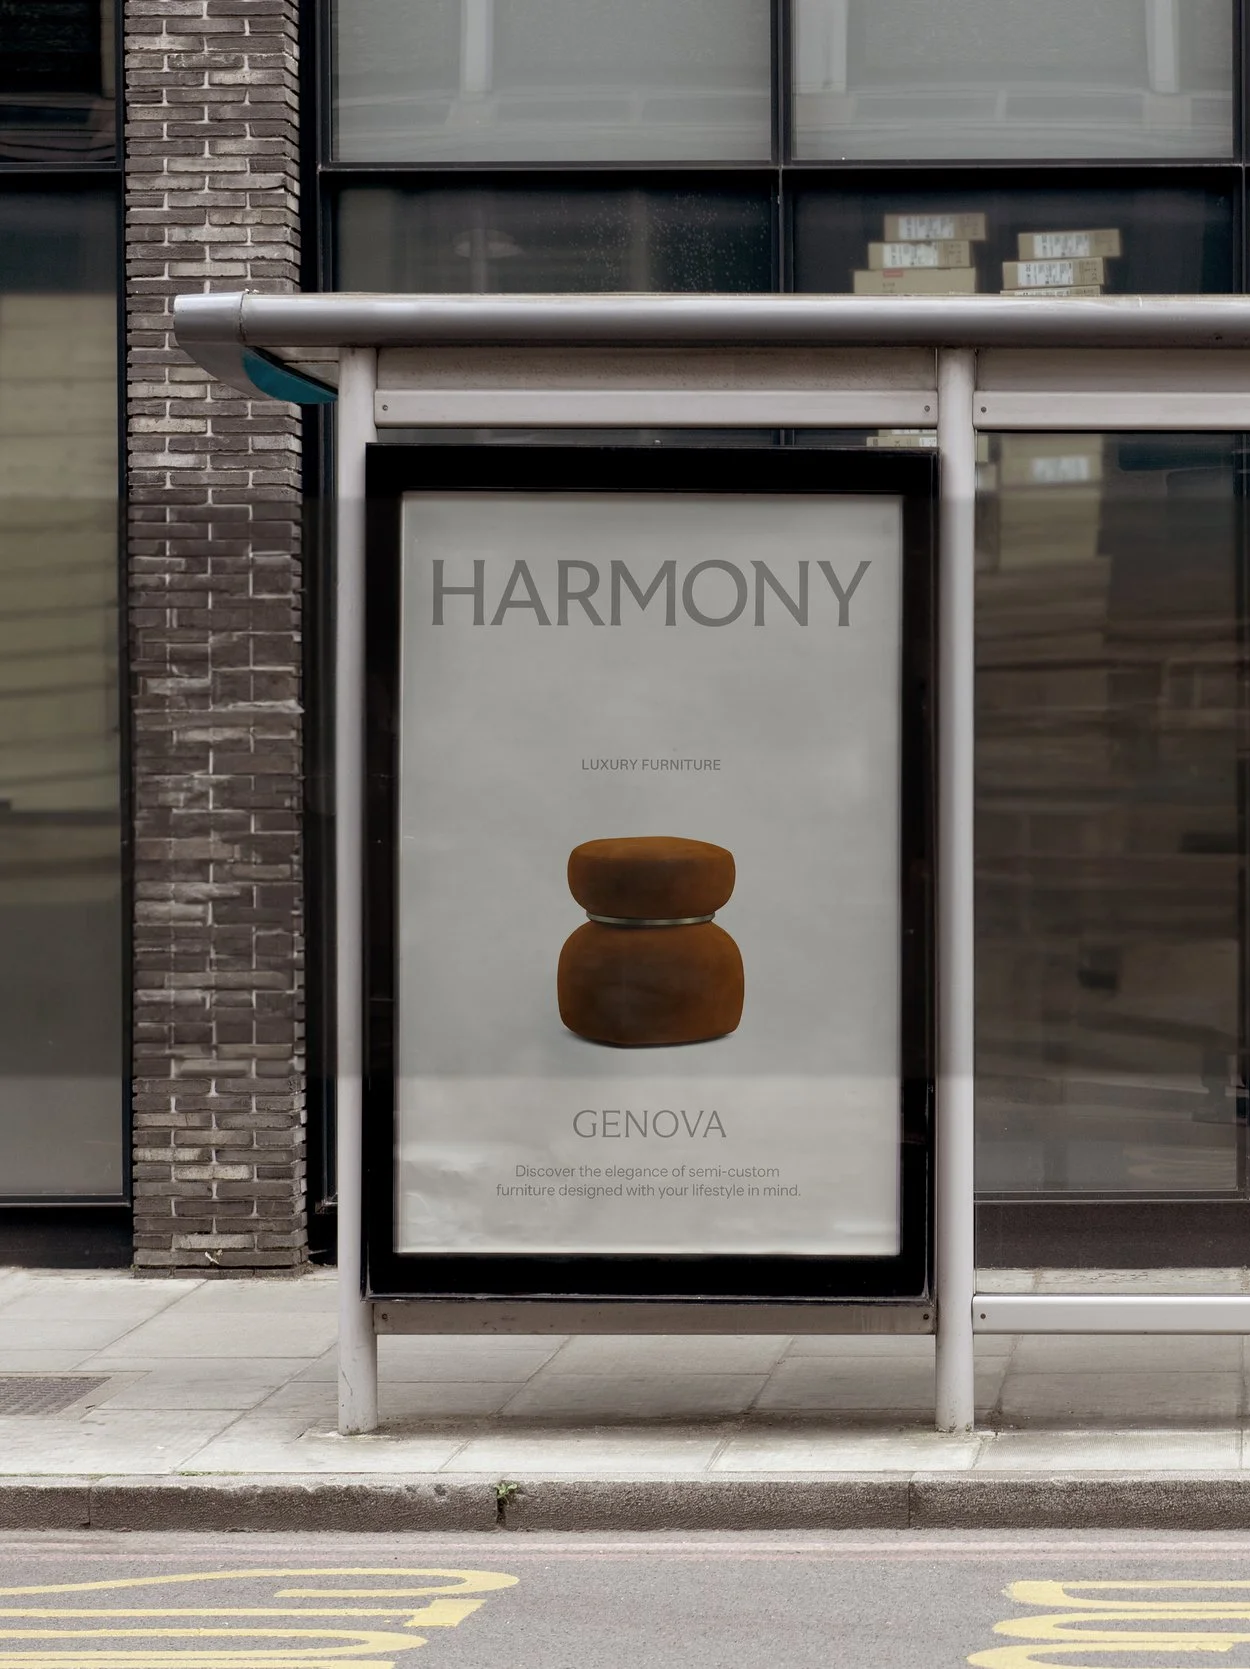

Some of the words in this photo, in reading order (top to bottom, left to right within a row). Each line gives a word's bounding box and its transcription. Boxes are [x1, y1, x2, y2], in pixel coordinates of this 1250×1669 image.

[432, 559, 872, 627] HARMONY
[581, 759, 638, 771] LUXURY
[641, 759, 721, 771] FURNITURE
[573, 1109, 727, 1139] GENOVA
[515, 1164, 576, 1178] Discover
[579, 1165, 602, 1178] the
[604, 1165, 668, 1181] elegance
[671, 1164, 686, 1178] of
[688, 1165, 780, 1178] semi-custom
[496, 1183, 556, 1197] furniture
[558, 1184, 623, 1200] designed
[626, 1184, 656, 1197] with
[658, 1187, 690, 1200] your
[692, 1183, 745, 1200] lifestyle
[747, 1184, 760, 1197] in
[763, 1183, 801, 1197] mind.
